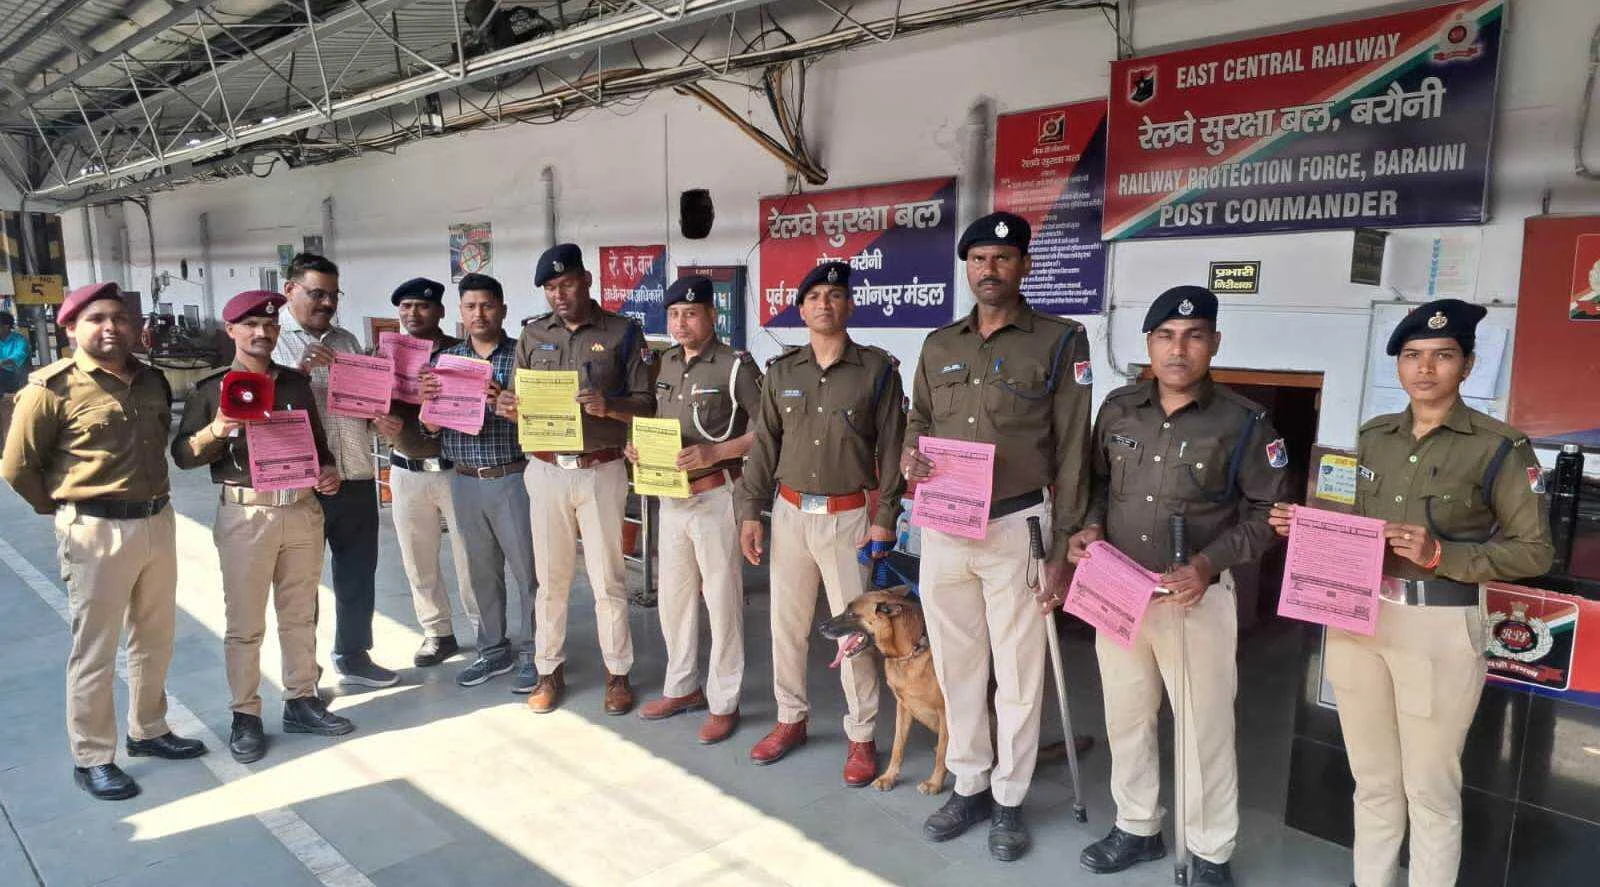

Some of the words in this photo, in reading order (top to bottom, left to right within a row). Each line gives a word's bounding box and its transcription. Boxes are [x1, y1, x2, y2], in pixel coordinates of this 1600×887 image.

[1176, 61, 1219, 89] EAST
[1223, 48, 1304, 82] CENTRAL
[1311, 32, 1401, 69] RAILWAY
[1138, 110, 1196, 150] रेलवे
[1200, 109, 1276, 156] सुरक्षा
[1280, 100, 1341, 132] बल,
[1350, 76, 1446, 125] बरौनी
[1118, 169, 1186, 196] RAILWAY
[1187, 158, 1293, 190] PROTECTION
[1299, 152, 1366, 182] FORCE,
[1374, 143, 1467, 176] BARAUNI
[768, 203, 818, 239] रेलवे
[823, 206, 889, 247] सुरक्षा
[894, 199, 944, 228] बल
[1159, 201, 1217, 228] POST
[1225, 190, 1398, 224] COMMANDER
[850, 249, 883, 270] बरौनी
[1215, 265, 1254, 278] प्रभारी
[765, 280, 785, 316] पूर्व
[852, 278, 903, 316] सोनपुर
[904, 276, 946, 307] मंडल
[1214, 279, 1254, 290] निरीक्षक
